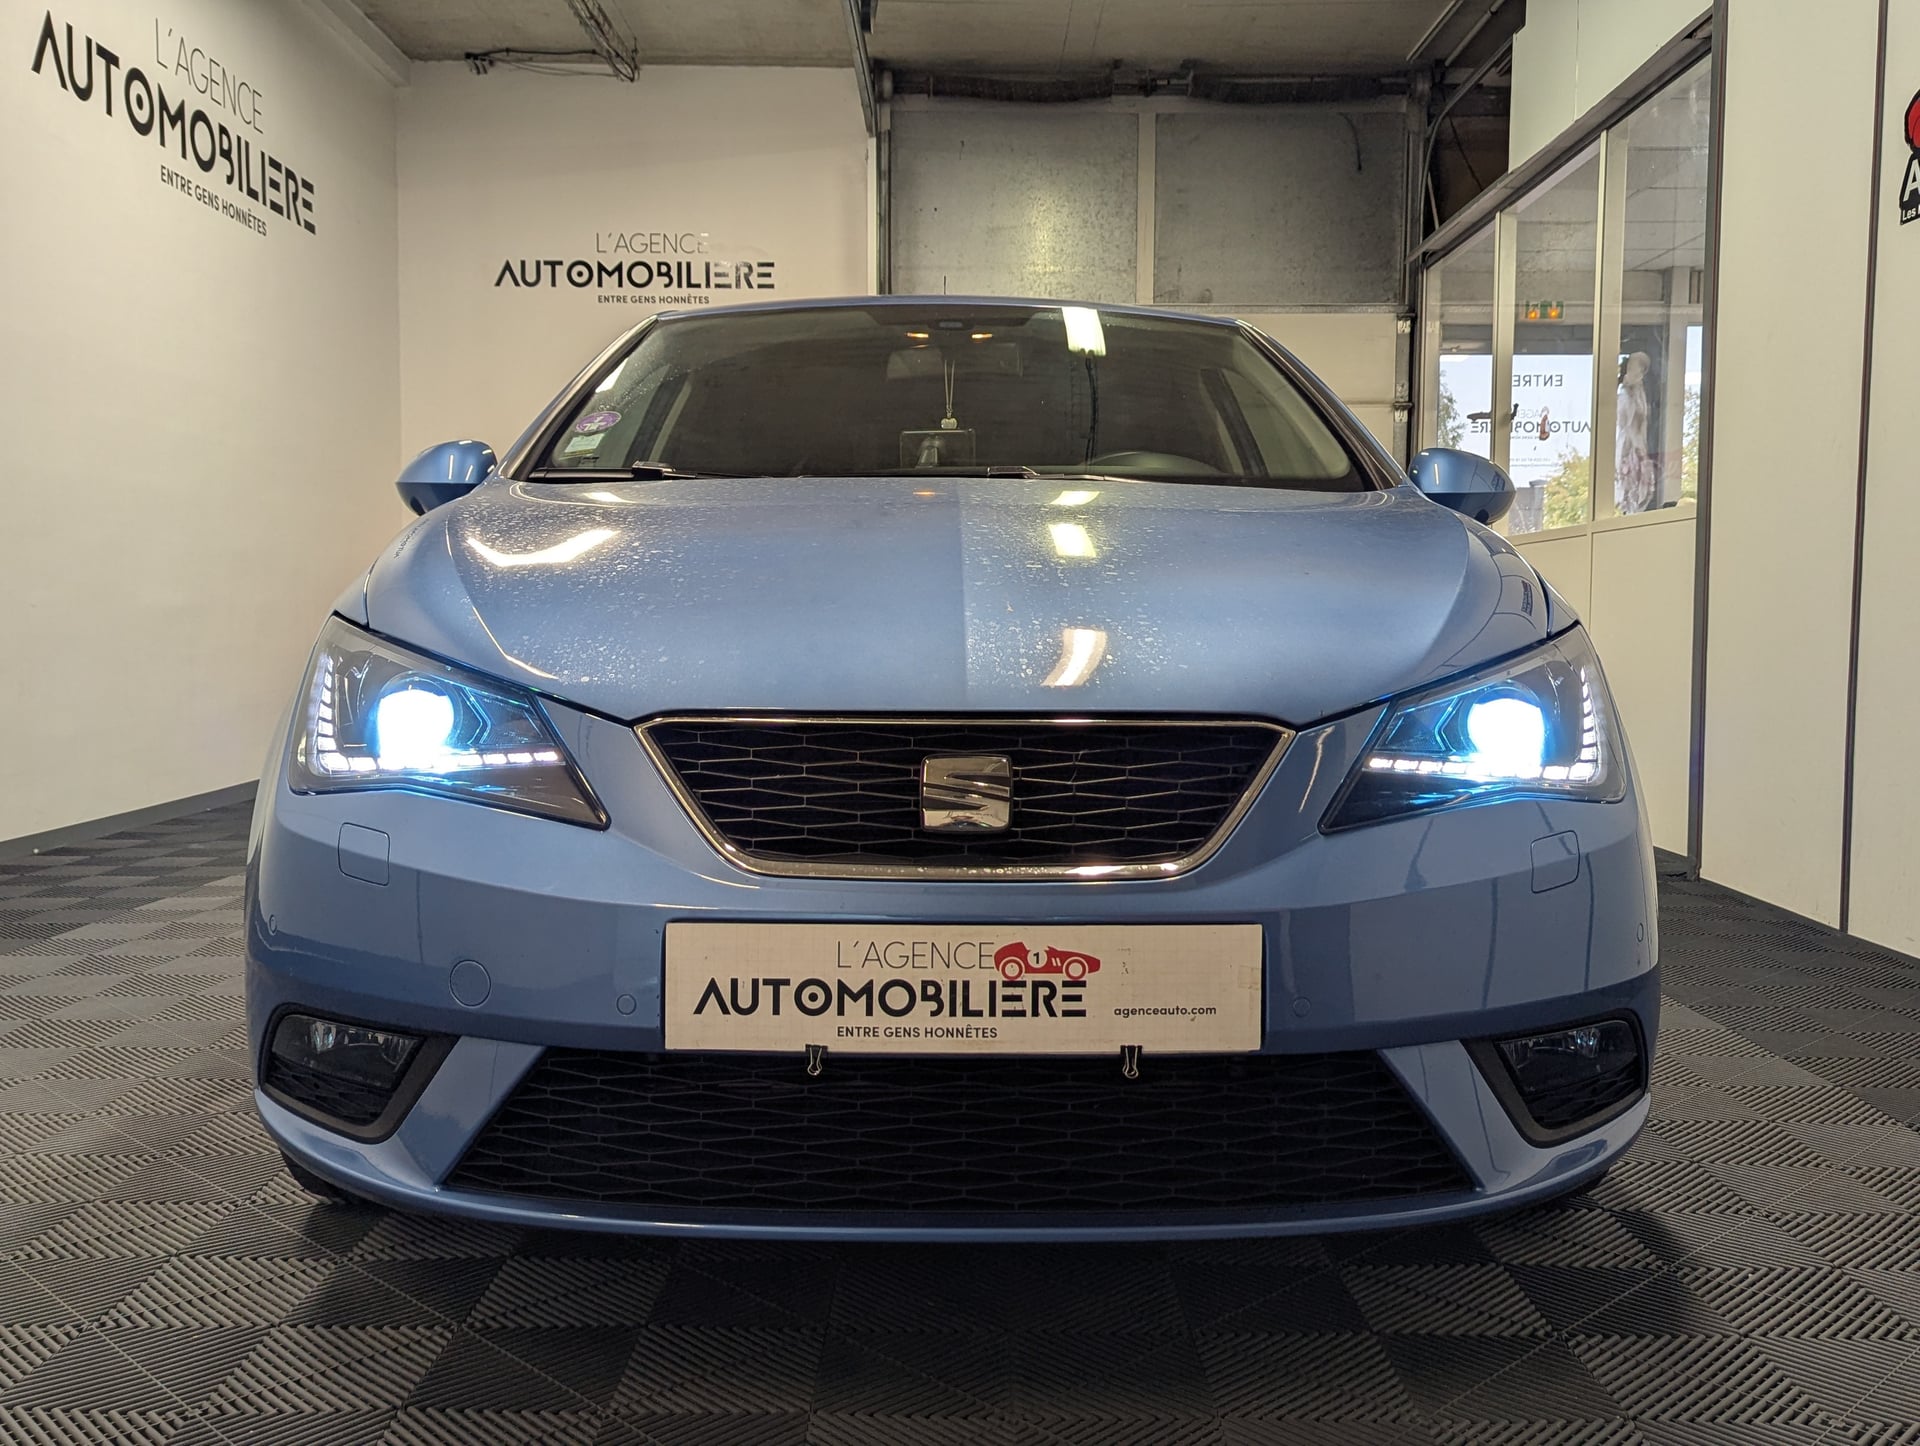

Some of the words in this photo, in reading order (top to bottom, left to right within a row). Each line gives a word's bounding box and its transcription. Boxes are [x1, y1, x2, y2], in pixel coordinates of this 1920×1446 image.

[155, 17, 264, 134] L'AGENCE
[31, 9, 316, 236] AUTOMOBILIERE
[160, 164, 193, 197] ENTRE
[194, 184, 220, 212] GENS
[221, 198, 267, 237] HONNÊTES
[1903, 207, 1917, 221] Les
[596, 232, 709, 254] L'AGENCE
[494, 259, 775, 289] AUTOMOBILIERE
[598, 295, 628, 304] ENTRE
[630, 295, 657, 304] GENS
[658, 293, 710, 304] HONNÊTES
[837, 940, 995, 970] L'AGENCE
[1033, 951, 1040, 965] 1
[693, 977, 1088, 1018] AUTOMOBILIERE
[1114, 1005, 1217, 1018] agenceauto.com
[837, 1026, 880, 1038] ENTRE
[883, 1026, 921, 1038] GENS
[924, 1024, 998, 1038] HONNÊTES
